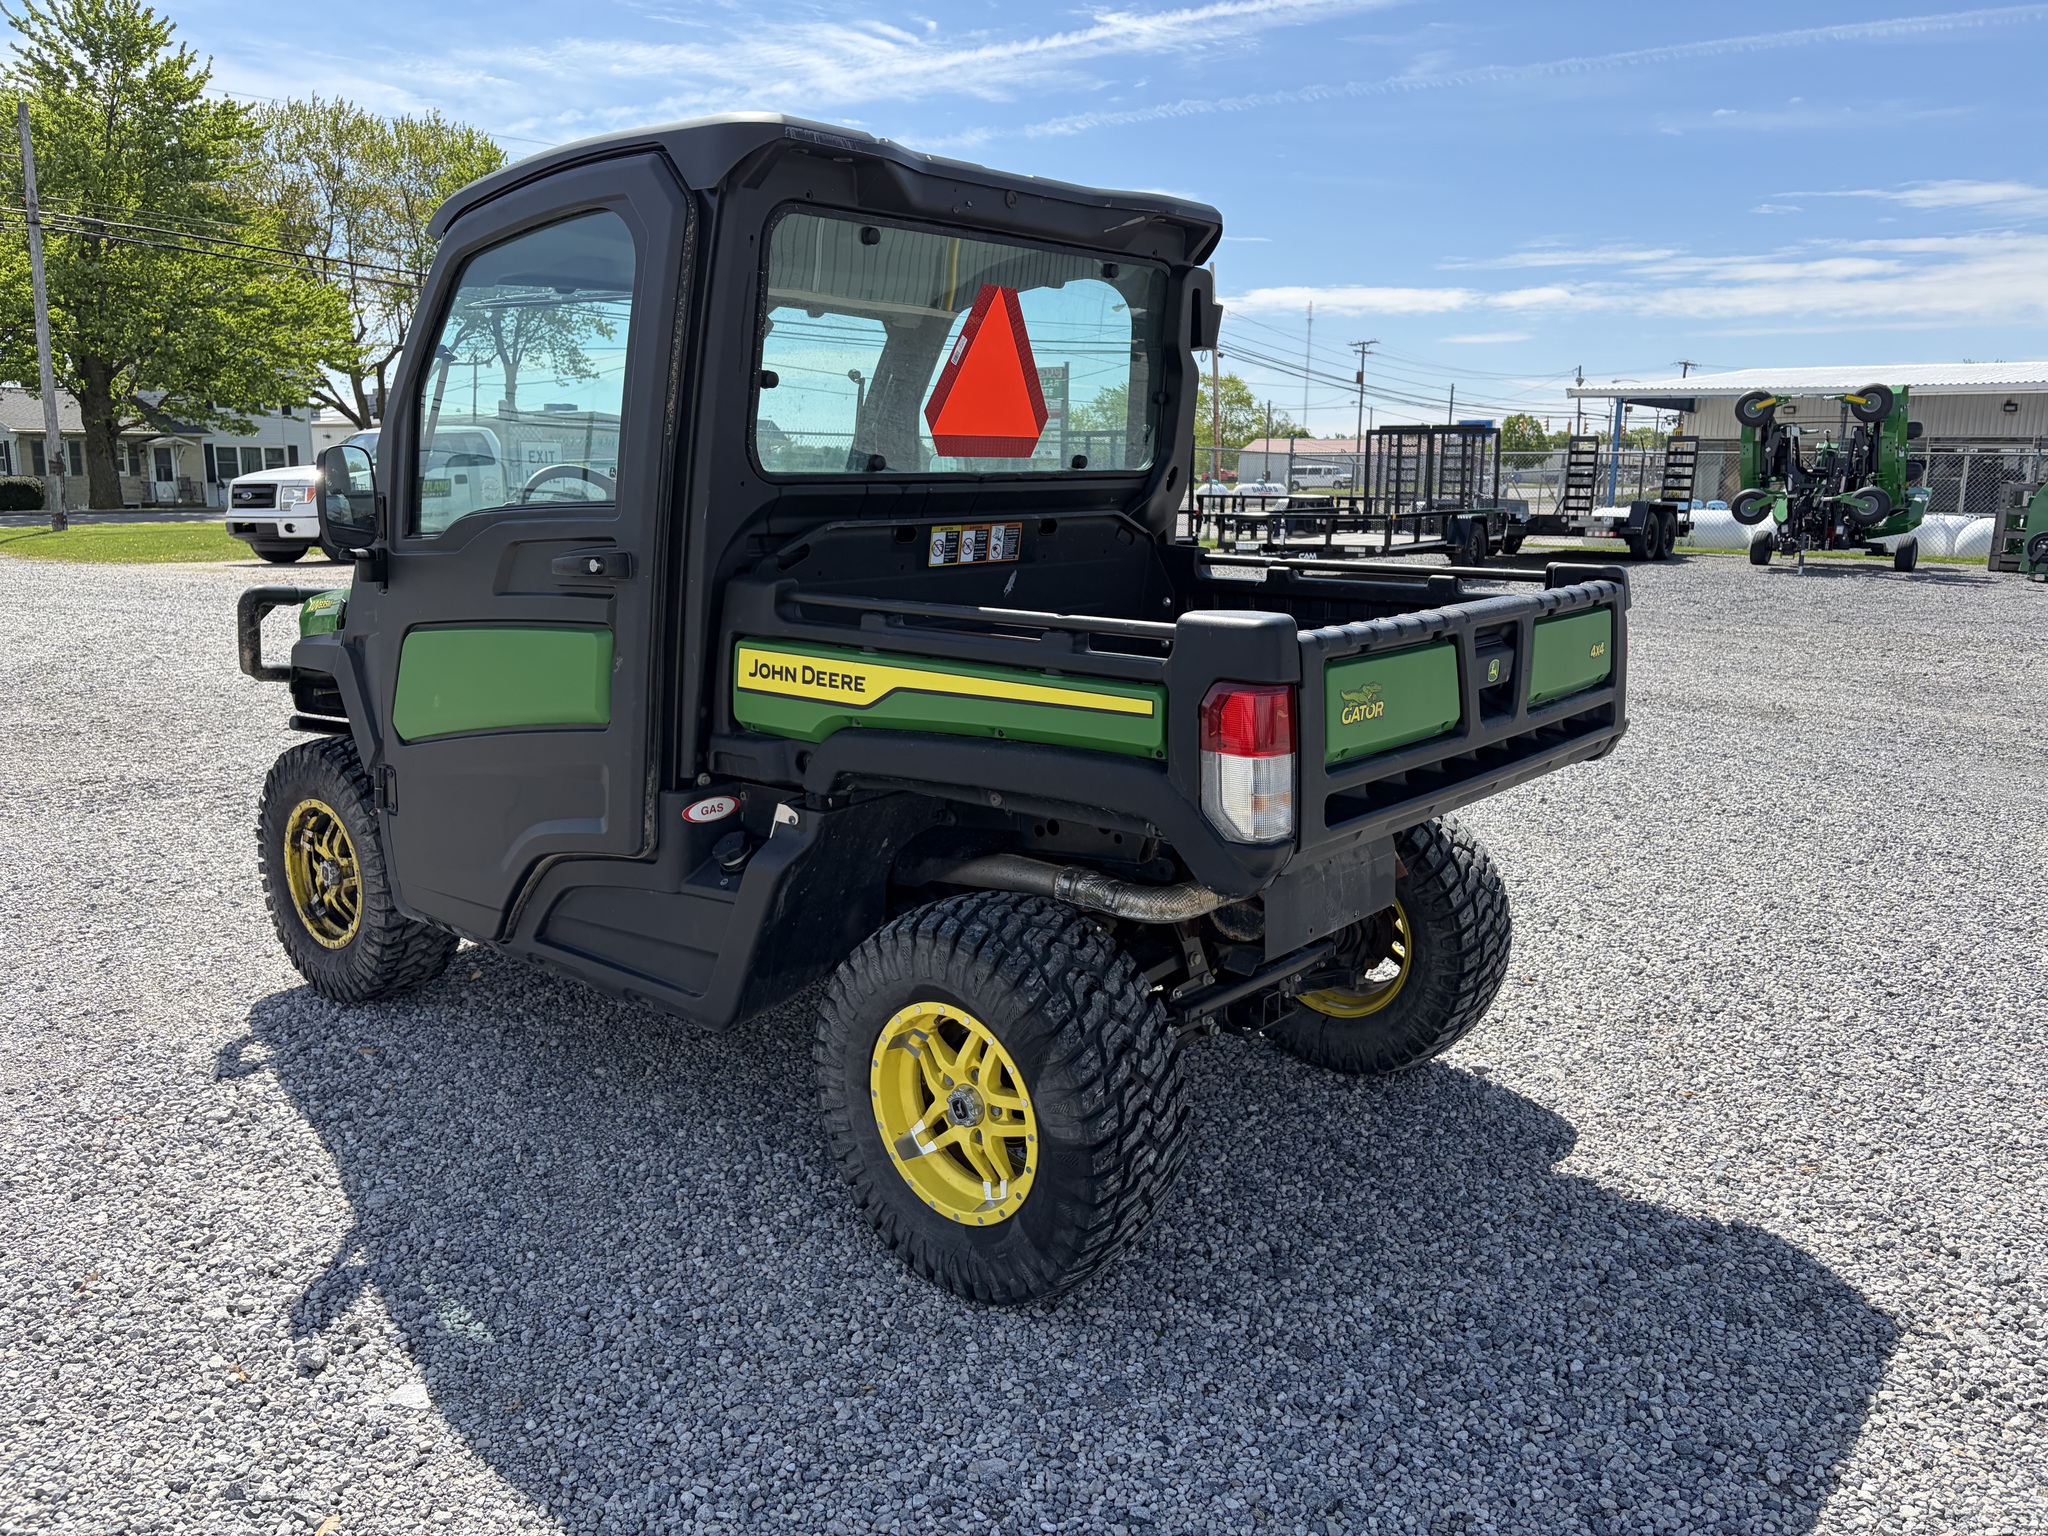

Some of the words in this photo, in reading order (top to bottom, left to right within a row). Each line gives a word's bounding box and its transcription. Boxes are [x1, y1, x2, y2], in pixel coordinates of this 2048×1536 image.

[528, 450, 556, 464] EXIT
[748, 658, 797, 683] JOHN
[801, 665, 866, 693] DEERE
[1341, 700, 1385, 725] GATOR
[700, 802, 724, 816] GAS
